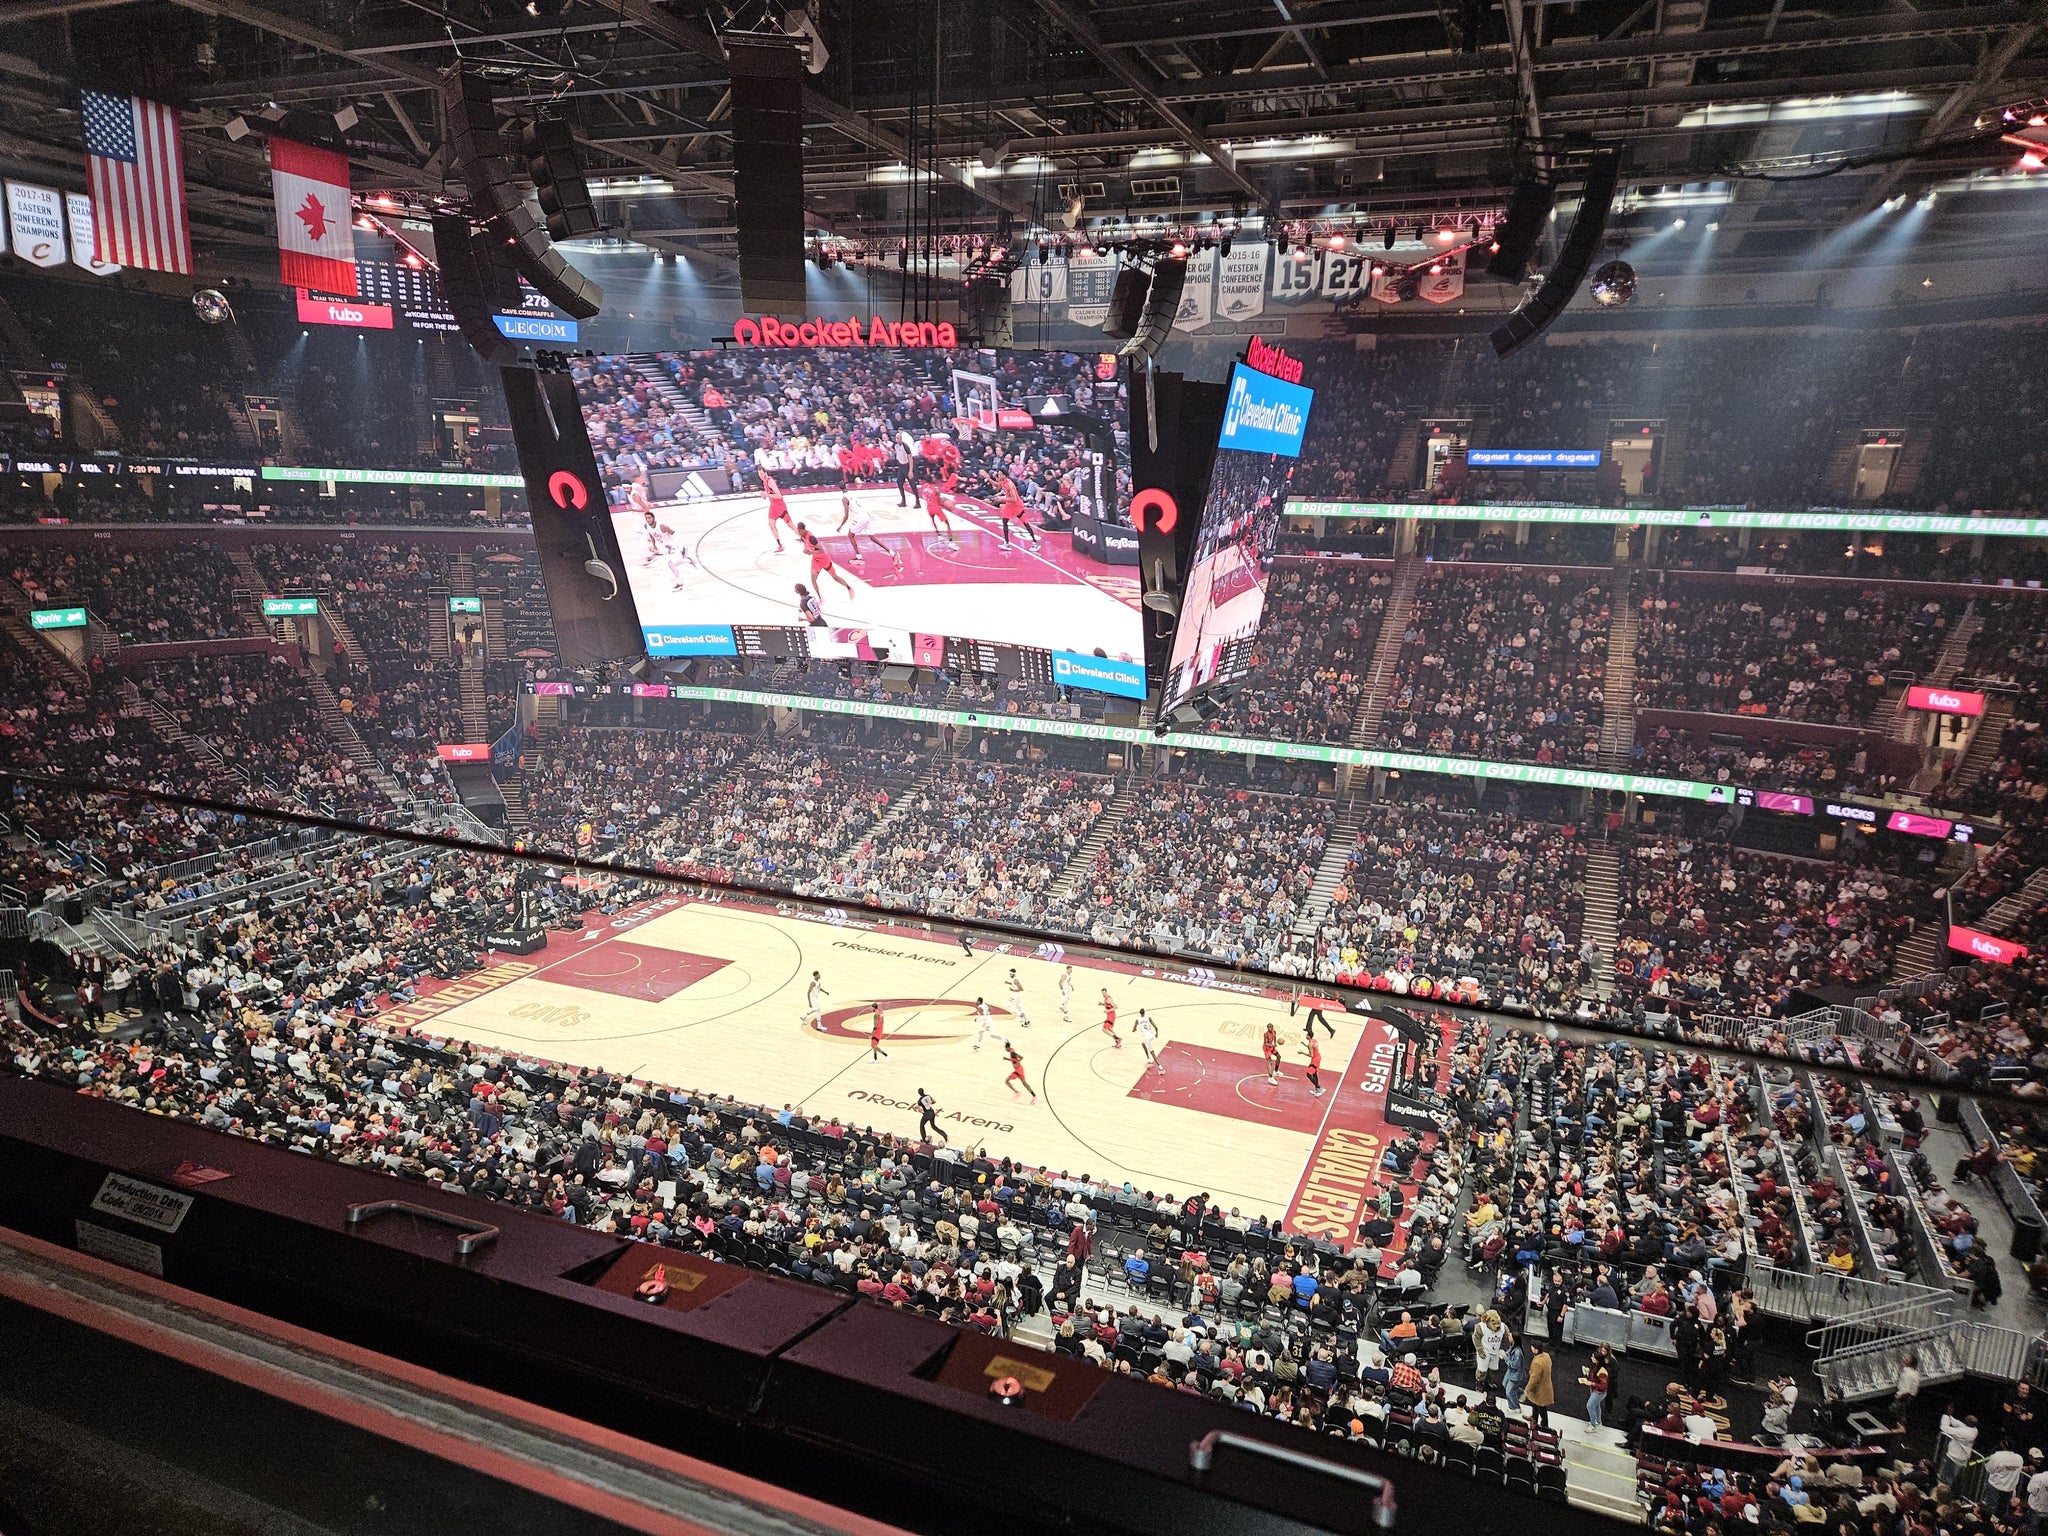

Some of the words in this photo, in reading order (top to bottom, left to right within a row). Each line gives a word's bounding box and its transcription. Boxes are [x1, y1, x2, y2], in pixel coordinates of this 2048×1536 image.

[14, 187, 52, 202] 2017-18
[17, 201, 52, 216] EASTERN
[12, 212, 60, 229] CONFERENCE
[16, 225, 59, 240] CHAMPIONS
[1226, 250, 1260, 260] 2015-16
[1198, 263, 1212, 272] CUP
[1227, 263, 1259, 273] WESTERN
[1281, 259, 1313, 290] 15
[1328, 258, 1364, 289] 27
[1041, 270, 1053, 299] 9
[1221, 273, 1264, 283] CONFERENCE
[1222, 284, 1261, 294] CHAMPIONS
[328, 305, 364, 323] fubo
[430, 312, 455, 321] WALTER
[760, 315, 864, 348] Rocket
[868, 314, 958, 348] Arena
[1275, 348, 1304, 384] Arena
[1239, 392, 1279, 431] Cleveland
[1274, 402, 1302, 436] Clinic
[1472, 452, 1491, 462] drug
[1490, 452, 1510, 461] mart
[1513, 452, 1533, 462] drug
[1533, 453, 1552, 461] mart
[1556, 452, 1576, 462] drug
[1576, 453, 1596, 461] mart
[17, 462, 52, 472] FOULS
[59, 463, 67, 473] 3
[107, 464, 115, 474] 7
[128, 465, 147, 473] 7:20
[147, 465, 161, 474] PM
[175, 466, 199, 475] LET
[217, 468, 257, 477] KNOW.
[319, 470, 338, 480] LET
[342, 470, 363, 480] 'EM
[366, 471, 406, 482] KNOW
[409, 472, 435, 483] YOU
[440, 474, 466, 484] GOT
[469, 475, 489, 486] THE
[491, 475, 526, 487] PAND
[1301, 501, 1342, 514] PRICE!
[1386, 504, 1408, 516] LET
[1410, 505, 1432, 517] 'EM
[1436, 506, 1480, 519] KNOW
[1484, 508, 1513, 519] YOU
[1517, 508, 1550, 520] GOT
[1550, 510, 1578, 521] THE
[1581, 510, 1630, 522] PANDA
[1636, 511, 1687, 523] PRICE!
[1728, 513, 1755, 525] LET
[1757, 513, 1785, 526] 'EM
[1788, 514, 1844, 527] KNOW
[1848, 516, 1883, 528] YOU
[1886, 517, 1927, 529] GOT
[1929, 518, 1962, 530] THE
[1964, 519, 2028, 532] PANDA
[1105, 536, 1139, 549] KeyBan
[267, 601, 294, 612] Sprite
[35, 613, 62, 626] Sprite
[663, 634, 703, 645] Cleveland
[704, 635, 729, 644] Clinic
[923, 652, 932, 663] 9
[1072, 663, 1114, 682] Cleveland
[1115, 670, 1140, 686] Clinic
[557, 684, 569, 694] 11
[595, 685, 611, 694] 7:58
[622, 686, 632, 694] 23
[636, 686, 644, 695] 9
[714, 690, 732, 699] LET
[756, 692, 791, 706] KNOW
[796, 696, 818, 707] YOU
[822, 699, 846, 711] GOT
[849, 701, 871, 713] THE
[874, 703, 914, 717] PANDA
[919, 708, 958, 721] PRICE!
[1928, 692, 1961, 708] fubo
[988, 715, 1007, 726] LET
[1036, 719, 1076, 733] KNOW
[1081, 725, 1107, 738] YOU
[1112, 729, 1140, 741] GOT
[1174, 733, 1223, 750] PANDA
[1228, 740, 1276, 755] PRICE!
[451, 748, 473, 757] fubo
[494, 747, 516, 760] COMCAST
[1329, 750, 1355, 762] LET
[1390, 754, 1442, 770] KNOW
[1446, 760, 1481, 774] YOU
[1485, 764, 1524, 778] GOT
[1526, 767, 1560, 782] THE
[1563, 771, 1625, 789] PANDA
[1630, 778, 1695, 796] PRICE!
[1791, 799, 1800, 810] 1
[1826, 804, 1876, 822] BLOCKS
[1897, 816, 1909, 830] 2
[610, 896, 680, 929] CLIFFS
[794, 911, 878, 931] TRUSTEDSEC
[1970, 937, 2002, 956] fubo
[847, 942, 908, 959] Rocket
[907, 952, 957, 967] Arena
[1160, 971, 1262, 996] TRUSTEDSEC
[378, 961, 539, 1029] CLEVELAND
[508, 1002, 591, 1028] CAVS
[1360, 1043, 1395, 1093] CLIFFS
[866, 1093, 943, 1118] Rockt
[945, 1110, 1015, 1133] Arena
[1390, 1102, 1429, 1119] KeyBank
[1290, 1127, 1380, 1240] CAVALIERS
[108, 1178, 160, 1202] Production
[159, 1195, 184, 1211] Date
